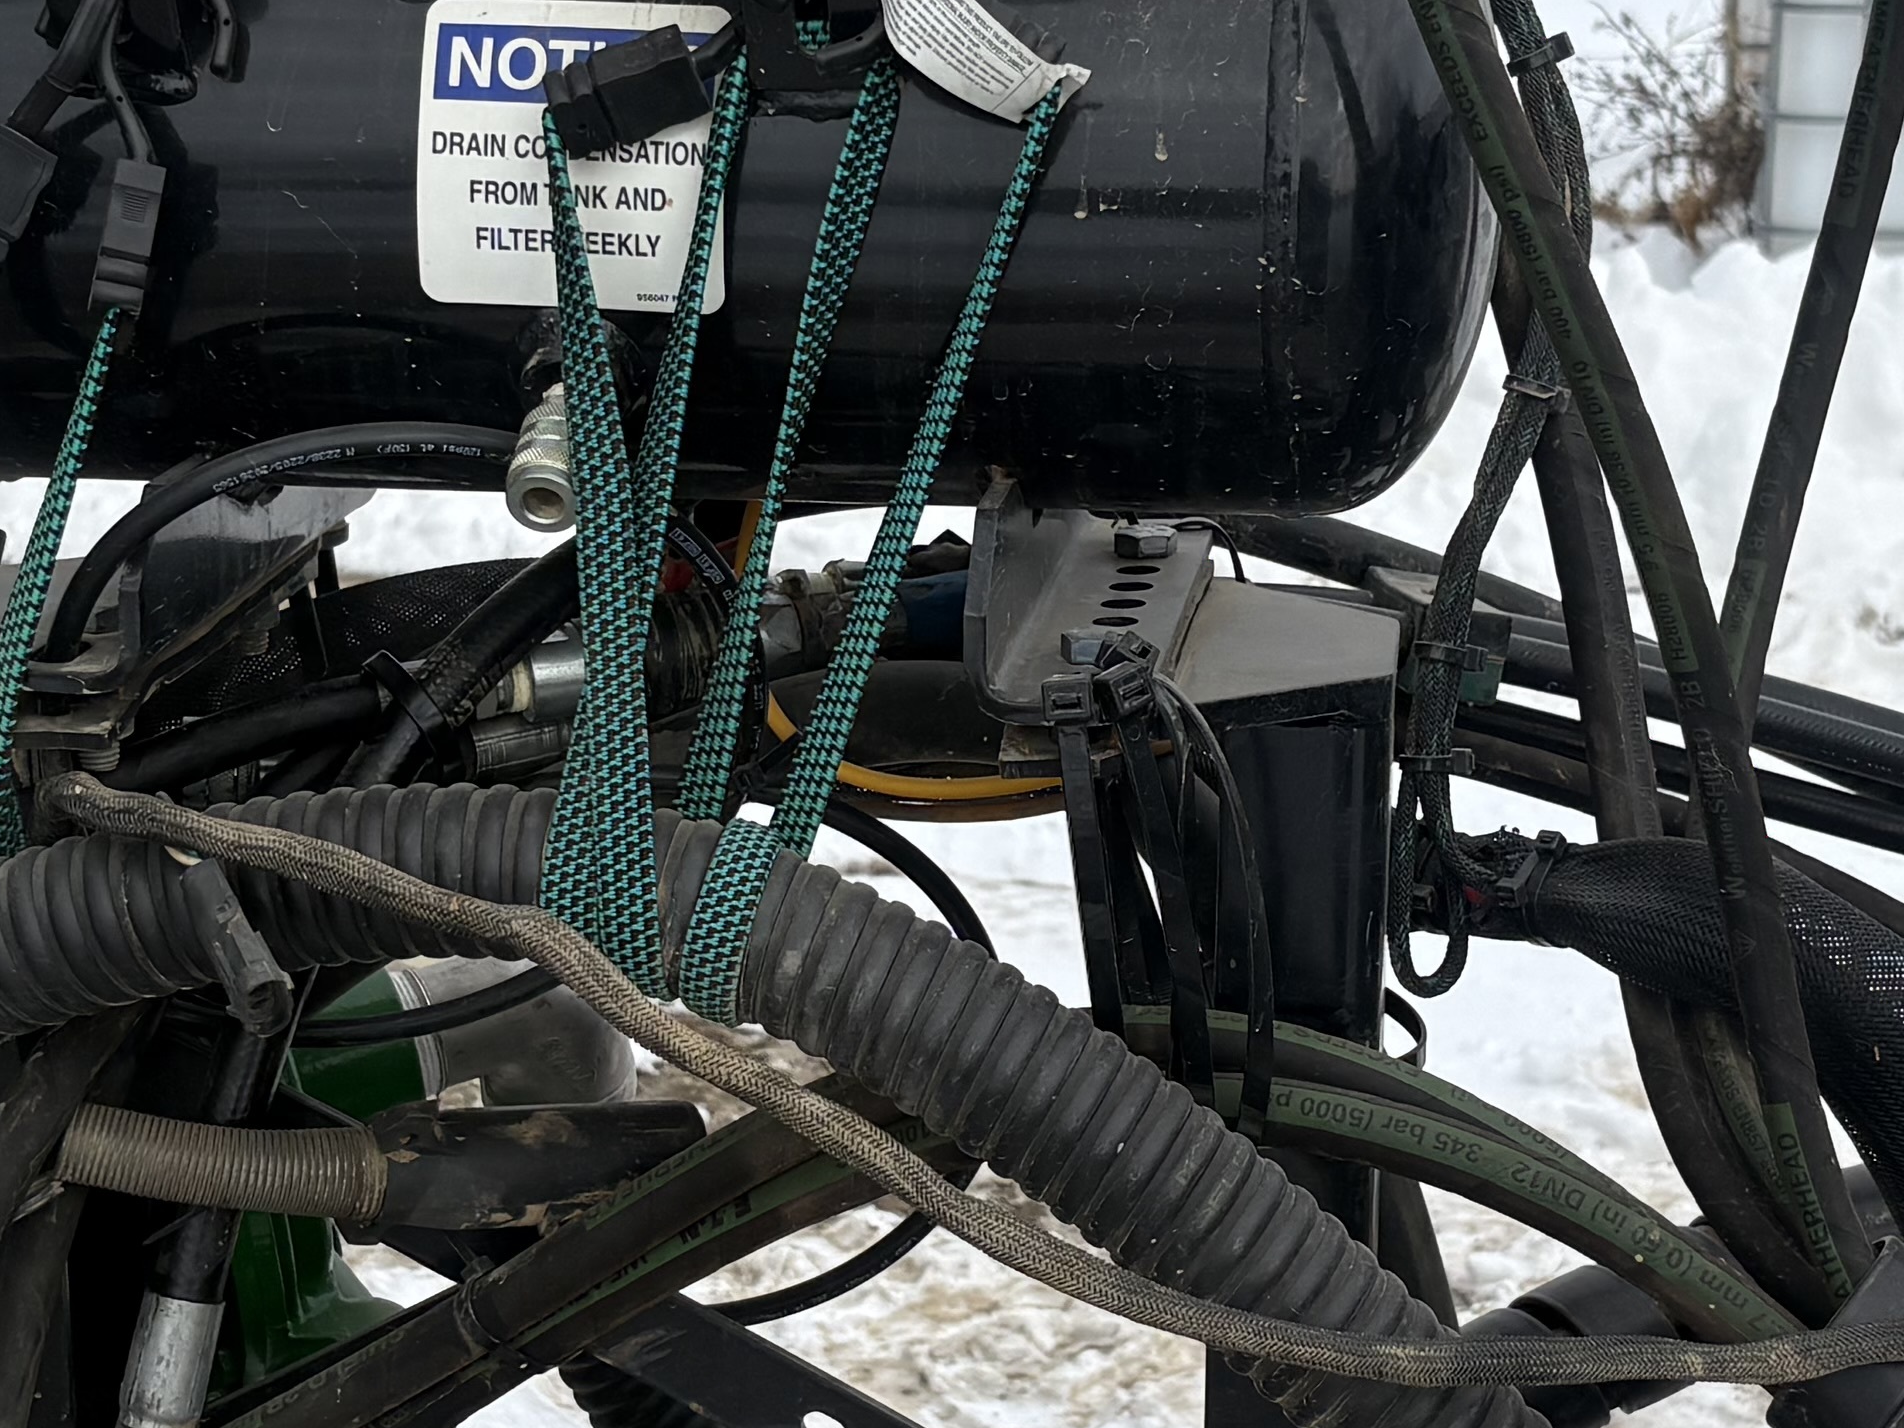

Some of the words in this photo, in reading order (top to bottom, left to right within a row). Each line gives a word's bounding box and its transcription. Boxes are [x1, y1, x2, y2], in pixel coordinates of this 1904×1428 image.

[1433, 39, 1489, 145] EXCEEDS
[431, 130, 507, 158] DRAIN
[469, 179, 538, 207] FROM
[615, 185, 667, 212] AND
[475, 226, 556, 254] FILTER
[584, 231, 662, 259] EEKLY
[1534, 269, 1562, 308] bar
[1298, 1095, 1378, 1138] (5000
[1380, 1108, 1432, 1149] bar
[1434, 1128, 1483, 1168] 345
[1508, 1159, 1587, 1213] DN12
[1591, 1194, 1635, 1235] in)
[1697, 1265, 1753, 1313] mm
